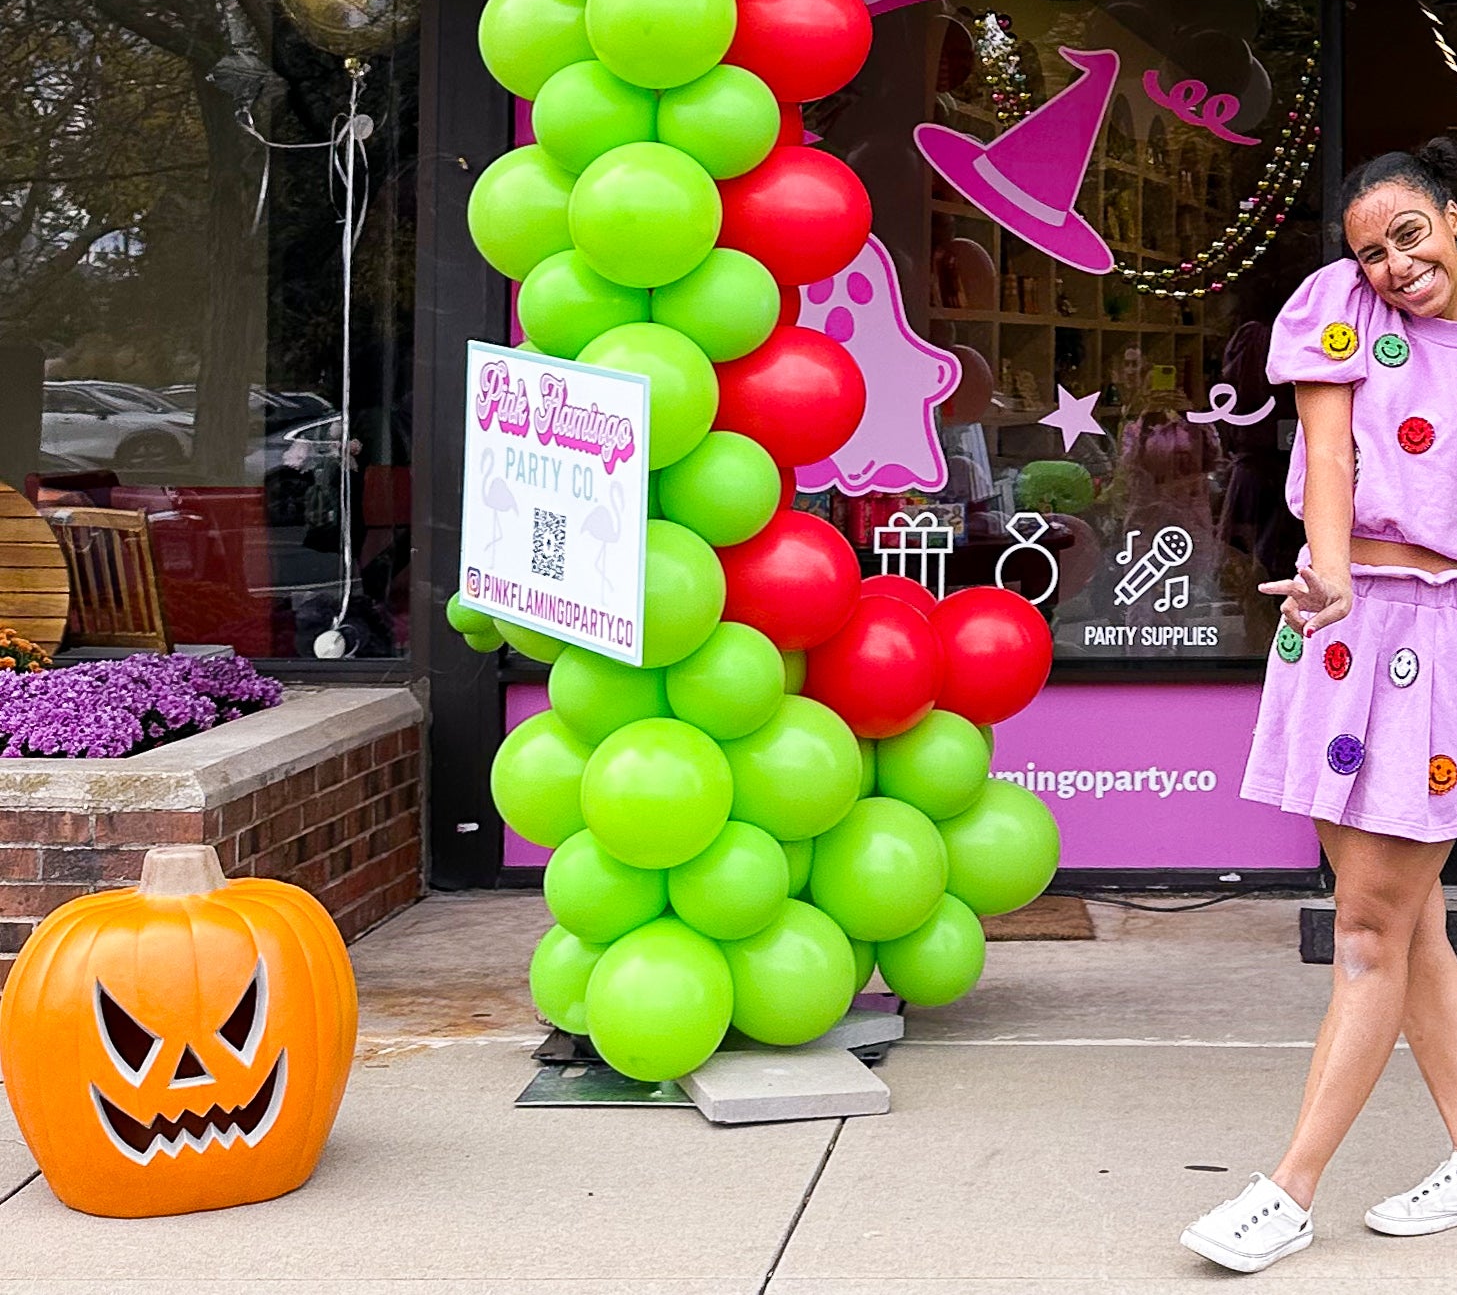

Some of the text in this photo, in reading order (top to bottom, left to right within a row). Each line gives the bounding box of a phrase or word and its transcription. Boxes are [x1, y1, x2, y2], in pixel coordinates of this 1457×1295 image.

[476, 360, 636, 475] Pink Flamingo
[505, 447, 598, 503] PARTY CO.
[483, 573, 633, 648] PINKFLAMINGOPARTY.CO
[1084, 626, 1218, 646] PARTY SUPPLIES
[988, 762, 1217, 799] mingoparty.co
